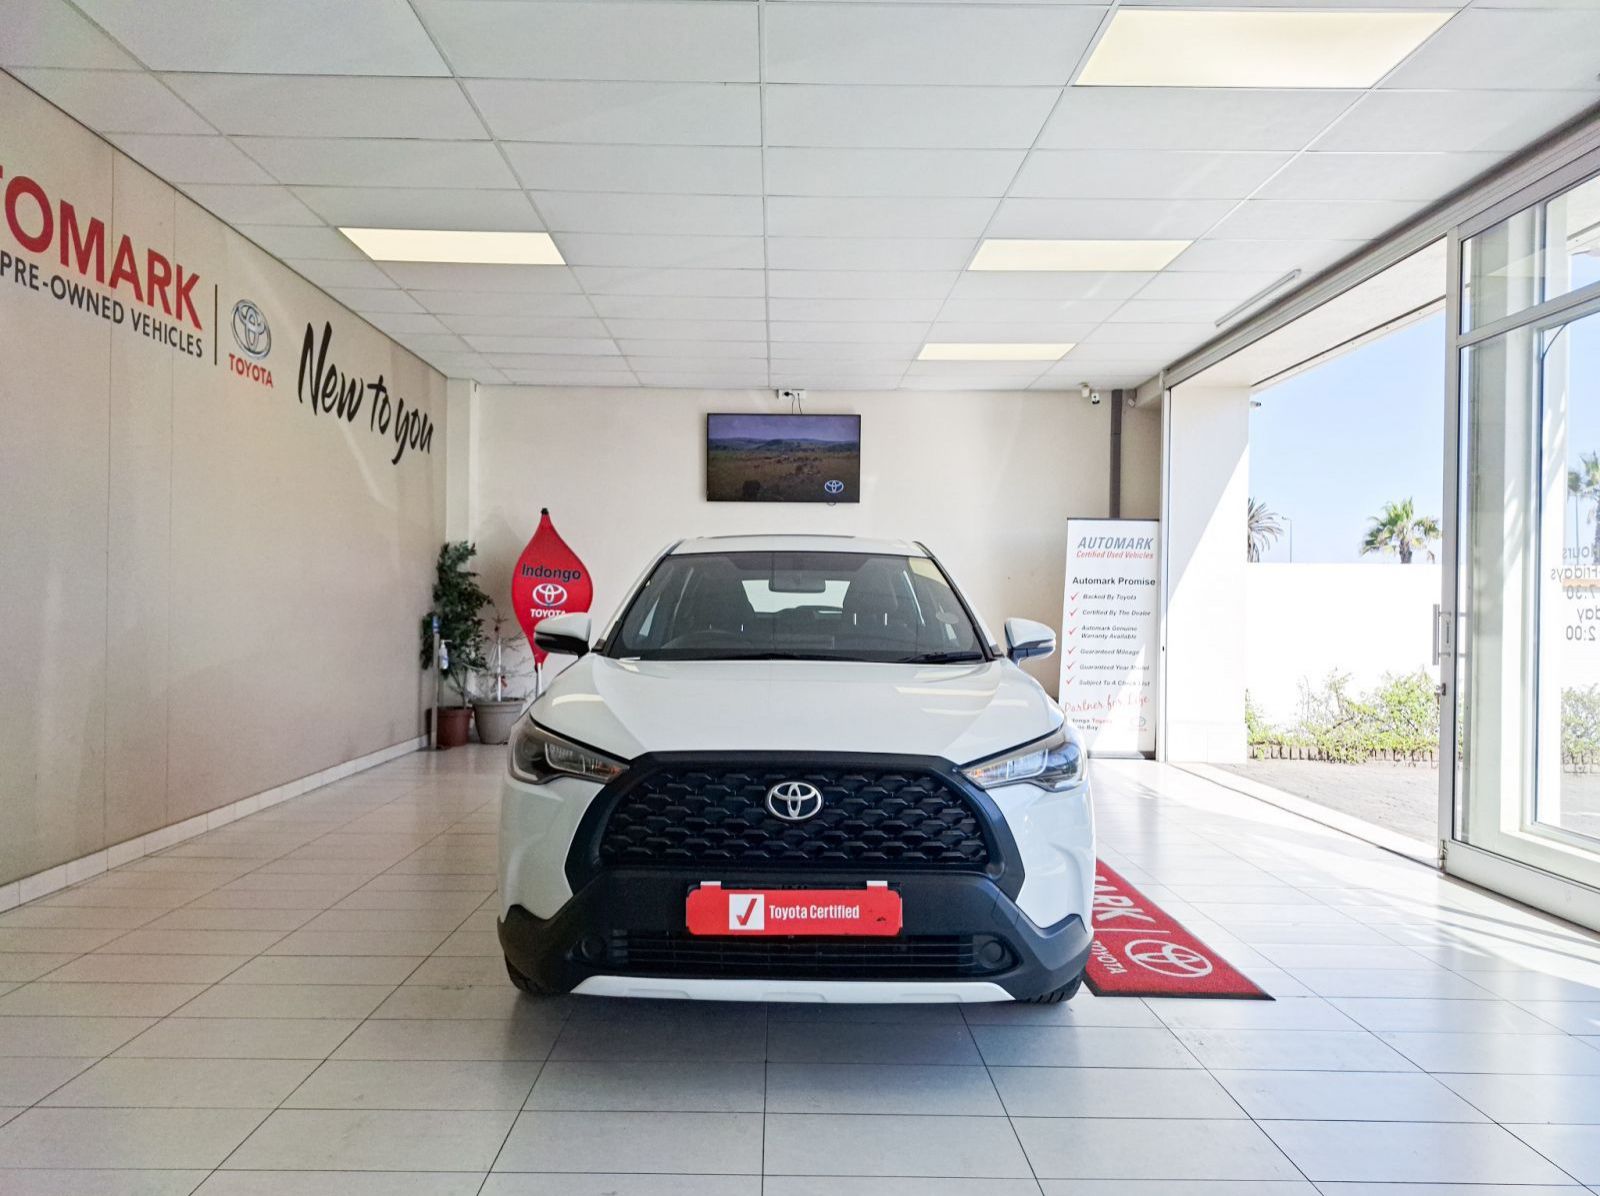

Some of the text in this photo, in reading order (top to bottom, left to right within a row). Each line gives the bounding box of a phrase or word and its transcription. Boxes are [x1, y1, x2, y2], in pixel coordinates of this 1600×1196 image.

[0, 165, 203, 331] OMARK
[0, 249, 203, 358] PRE-OWNED VEHICLES
[229, 352, 274, 388] TOYOTA
[299, 320, 434, 465] New to you
[1077, 536, 1154, 550] AUTOMARK
[1076, 549, 1154, 560] Certified Used Vehicles
[521, 563, 581, 582] Indongo
[1072, 577, 1156, 586] Automark Promise
[769, 904, 861, 921] Toyota Certified
